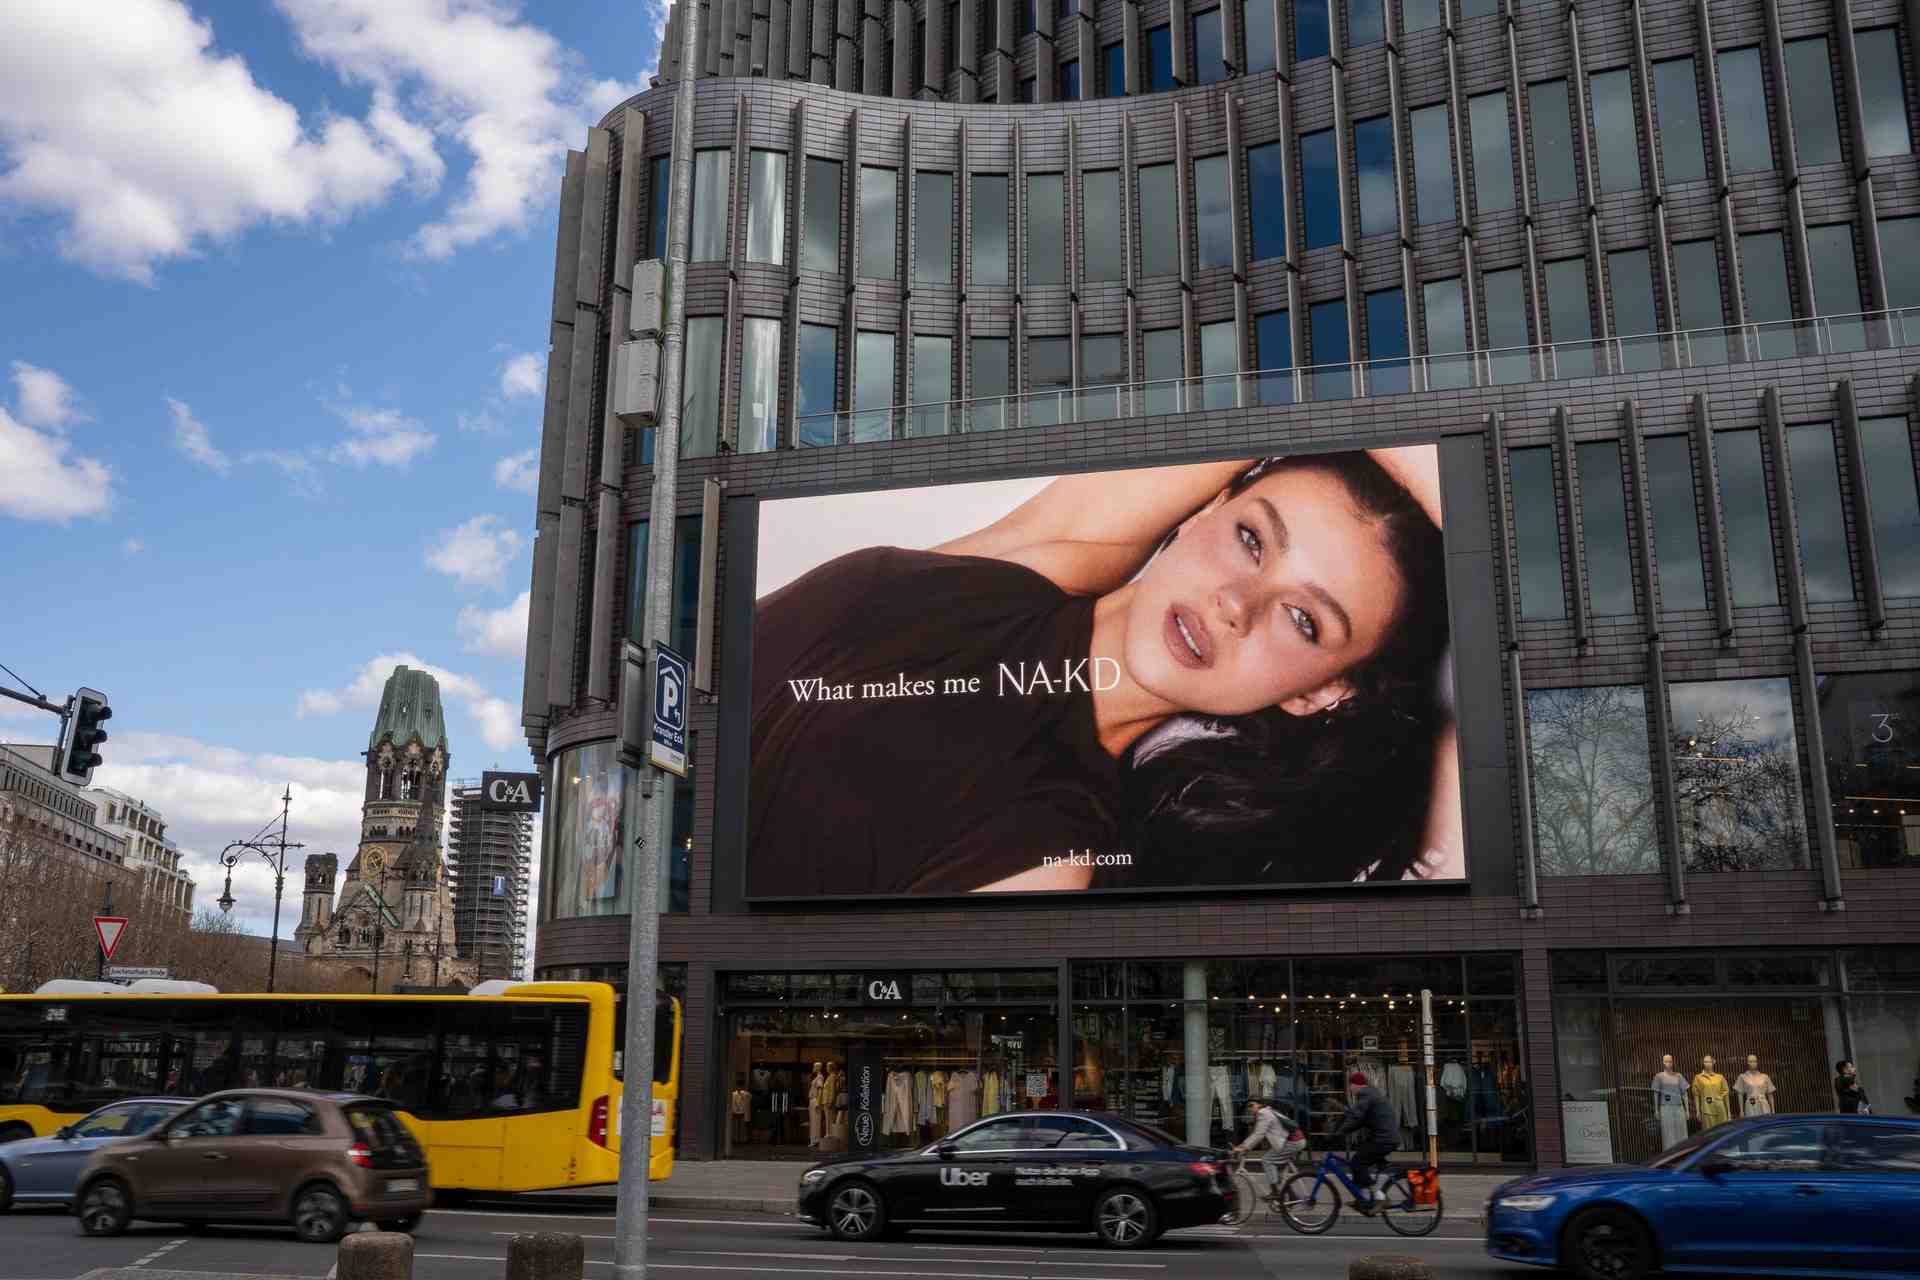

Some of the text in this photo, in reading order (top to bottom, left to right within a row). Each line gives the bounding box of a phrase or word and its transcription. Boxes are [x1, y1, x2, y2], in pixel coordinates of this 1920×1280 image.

[788, 656, 1121, 703] What makes me NA-KD
[488, 779, 533, 804] C&A
[1043, 848, 1134, 867] na-kd.com
[868, 980, 902, 1000] C&A
[859, 1065, 871, 1142] Neue Kollektion
[940, 1167, 992, 1186] Uber
